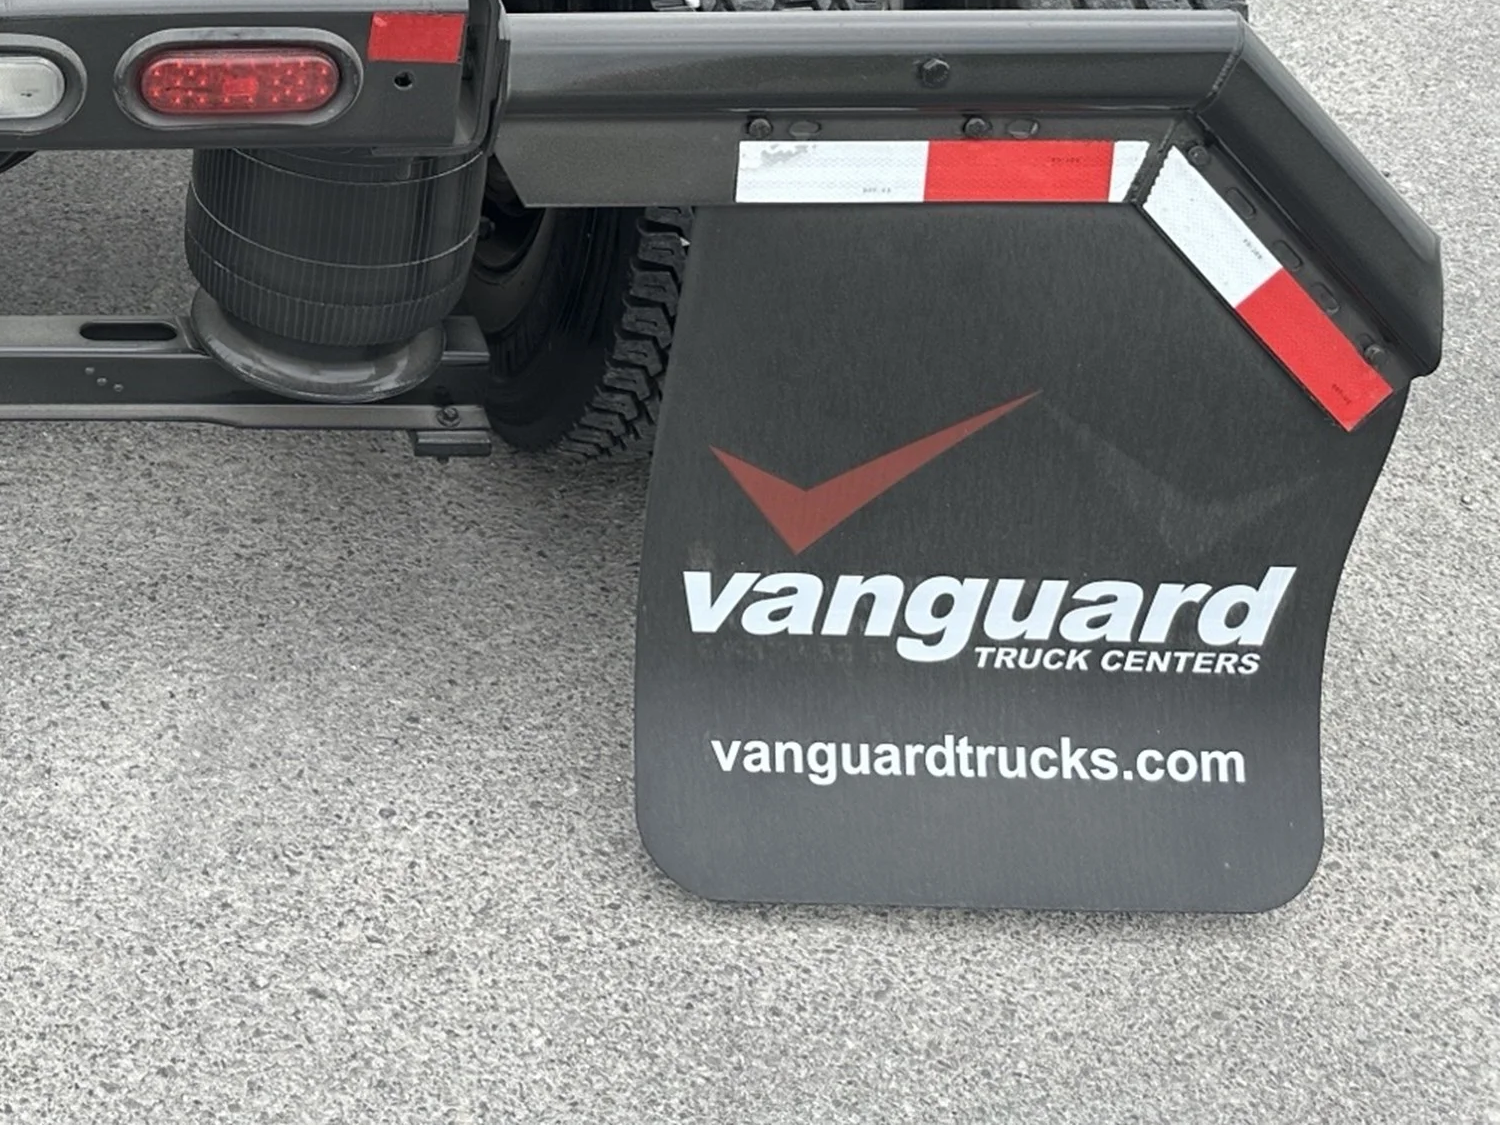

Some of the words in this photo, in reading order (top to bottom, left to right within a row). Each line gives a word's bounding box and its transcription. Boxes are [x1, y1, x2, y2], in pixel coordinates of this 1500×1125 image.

[682, 566, 1298, 664] vanguard
[974, 646, 1092, 672] TRUCK
[1100, 649, 1262, 676] CENTERS
[709, 734, 1247, 787] vanguardtrucks.com
